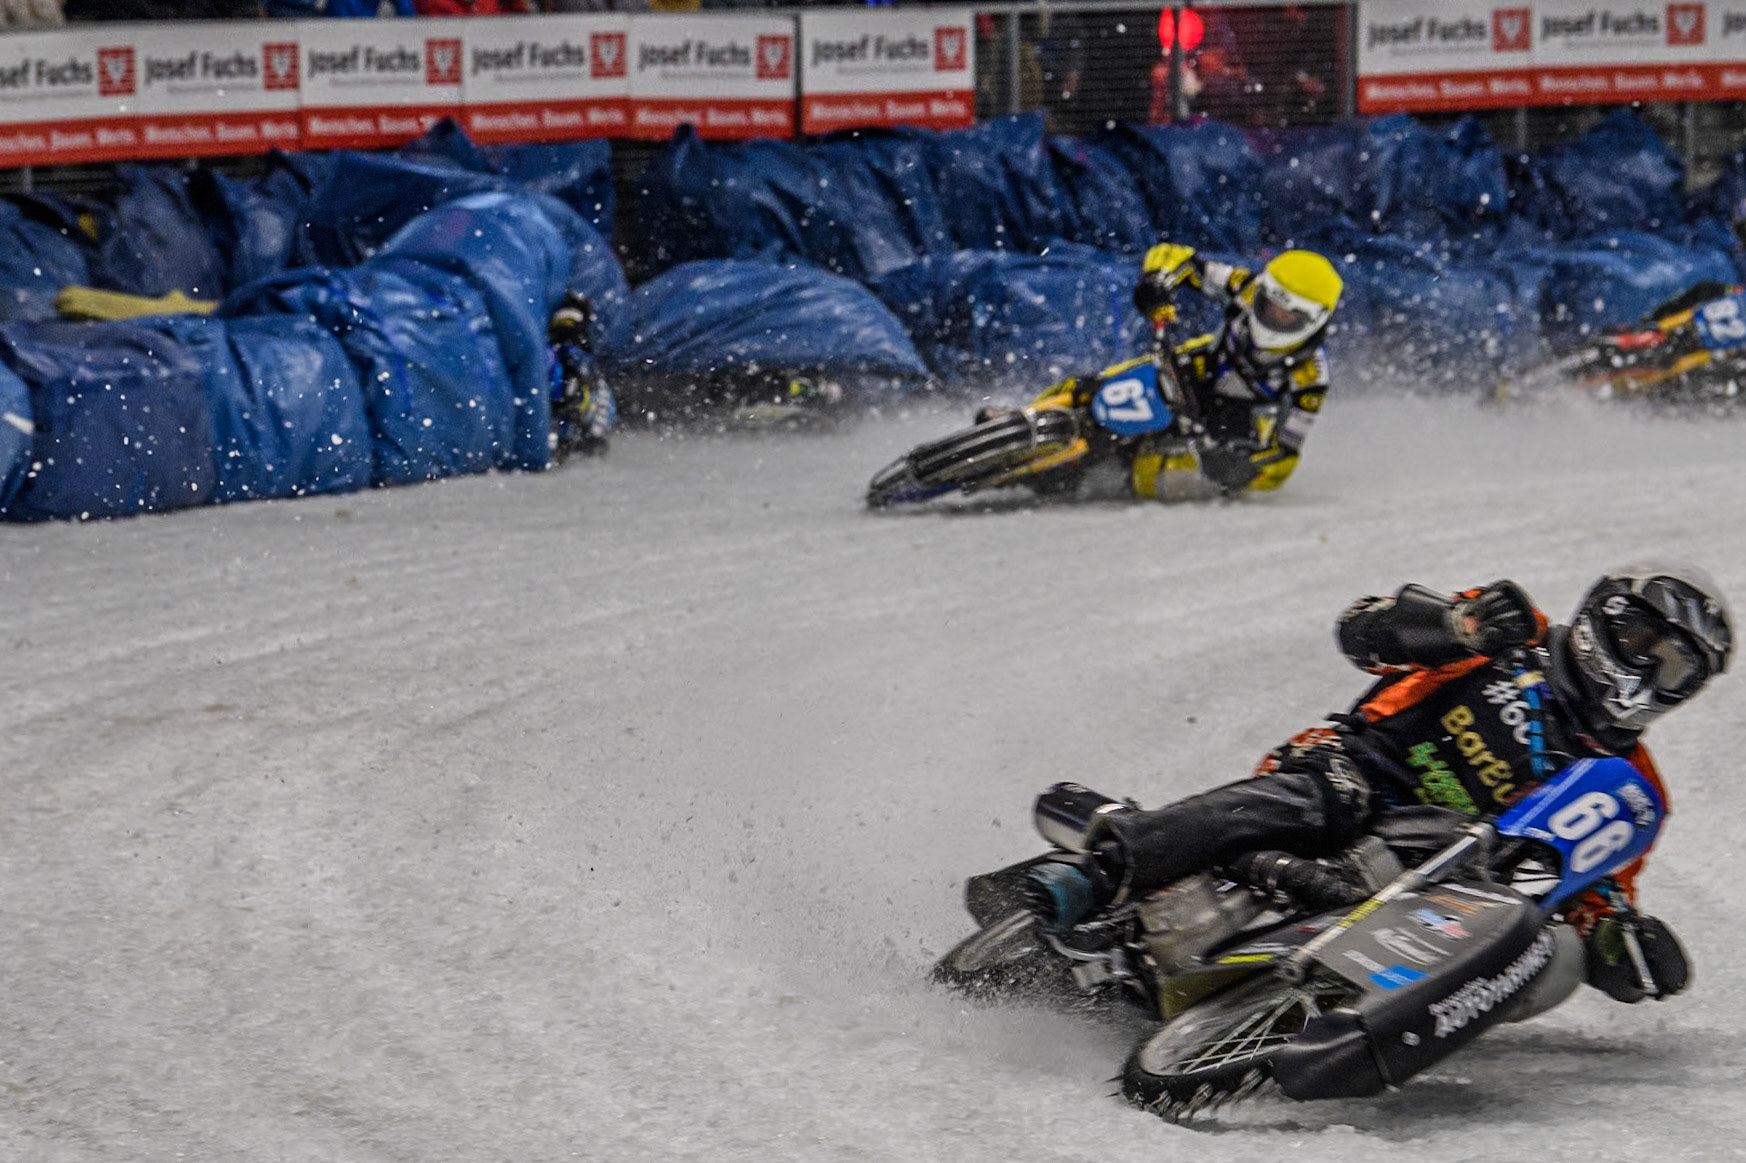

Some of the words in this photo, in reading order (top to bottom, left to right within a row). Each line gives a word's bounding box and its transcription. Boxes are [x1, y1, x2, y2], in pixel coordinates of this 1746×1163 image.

[308, 46, 361, 77] Josef
[364, 49, 420, 74] Fuchs
[472, 41, 526, 71] Josef
[530, 42, 585, 66] Fuchs
[638, 40, 692, 70] Josef
[699, 42, 751, 67] Fuchs
[812, 34, 868, 66] Josef
[875, 34, 929, 58] Fuchs
[36, 56, 93, 86] Fuchs
[145, 51, 203, 81] Josef
[206, 53, 257, 79] Fuchs
[1101, 378, 1154, 421] 67
[1548, 791, 1634, 874] 66
